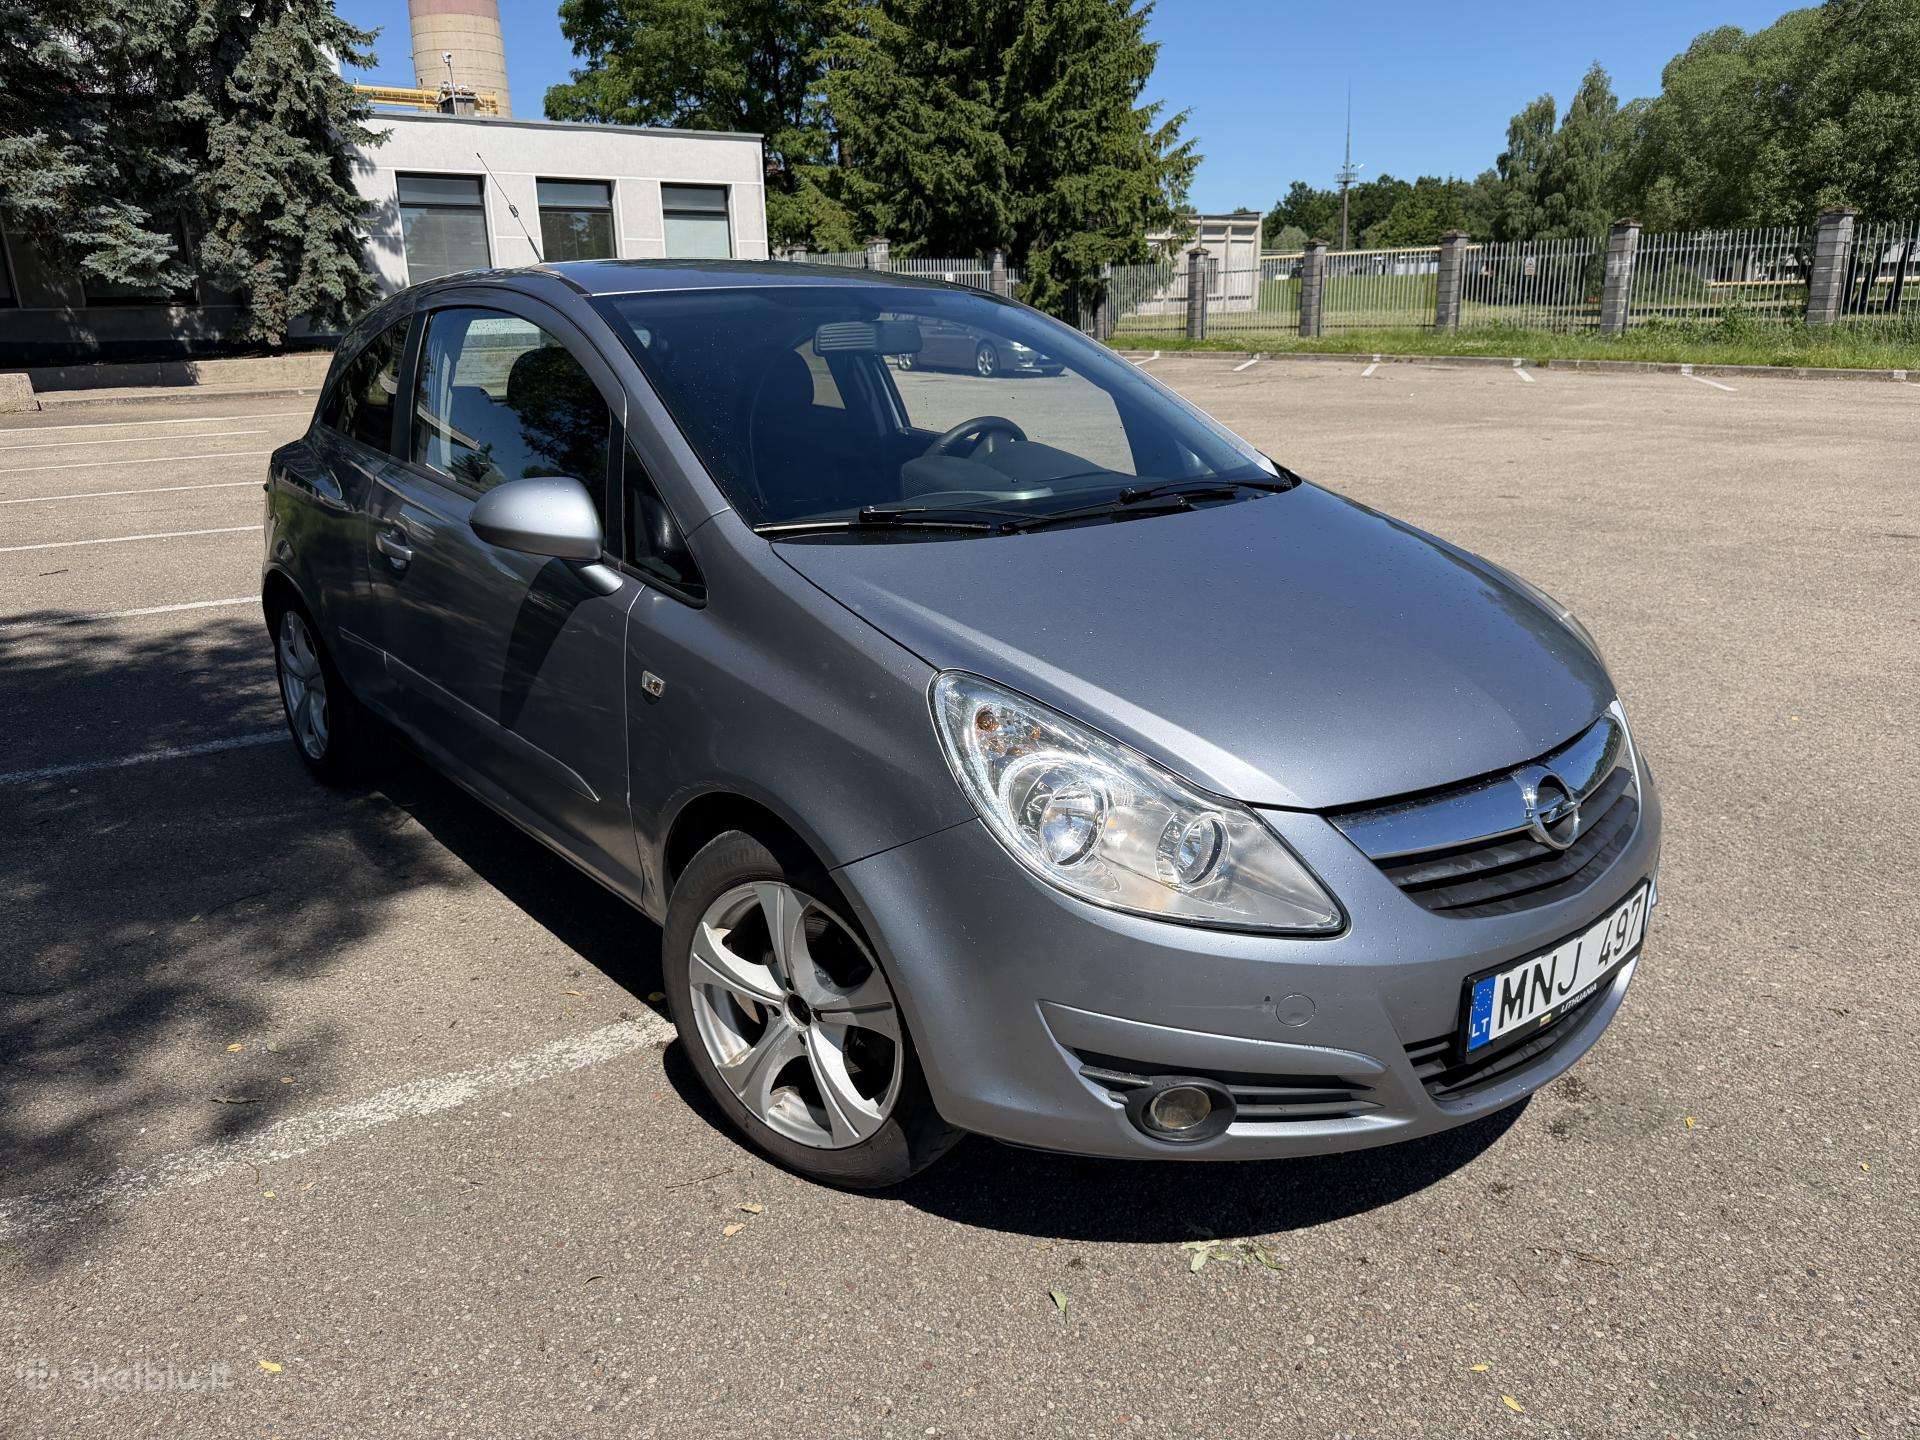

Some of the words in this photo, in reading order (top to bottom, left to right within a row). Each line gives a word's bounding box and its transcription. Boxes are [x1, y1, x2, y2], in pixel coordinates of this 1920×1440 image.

[1471, 1016, 1490, 1038] LT
[1498, 941, 1583, 1030] MNJ
[1598, 893, 1644, 967] 497
